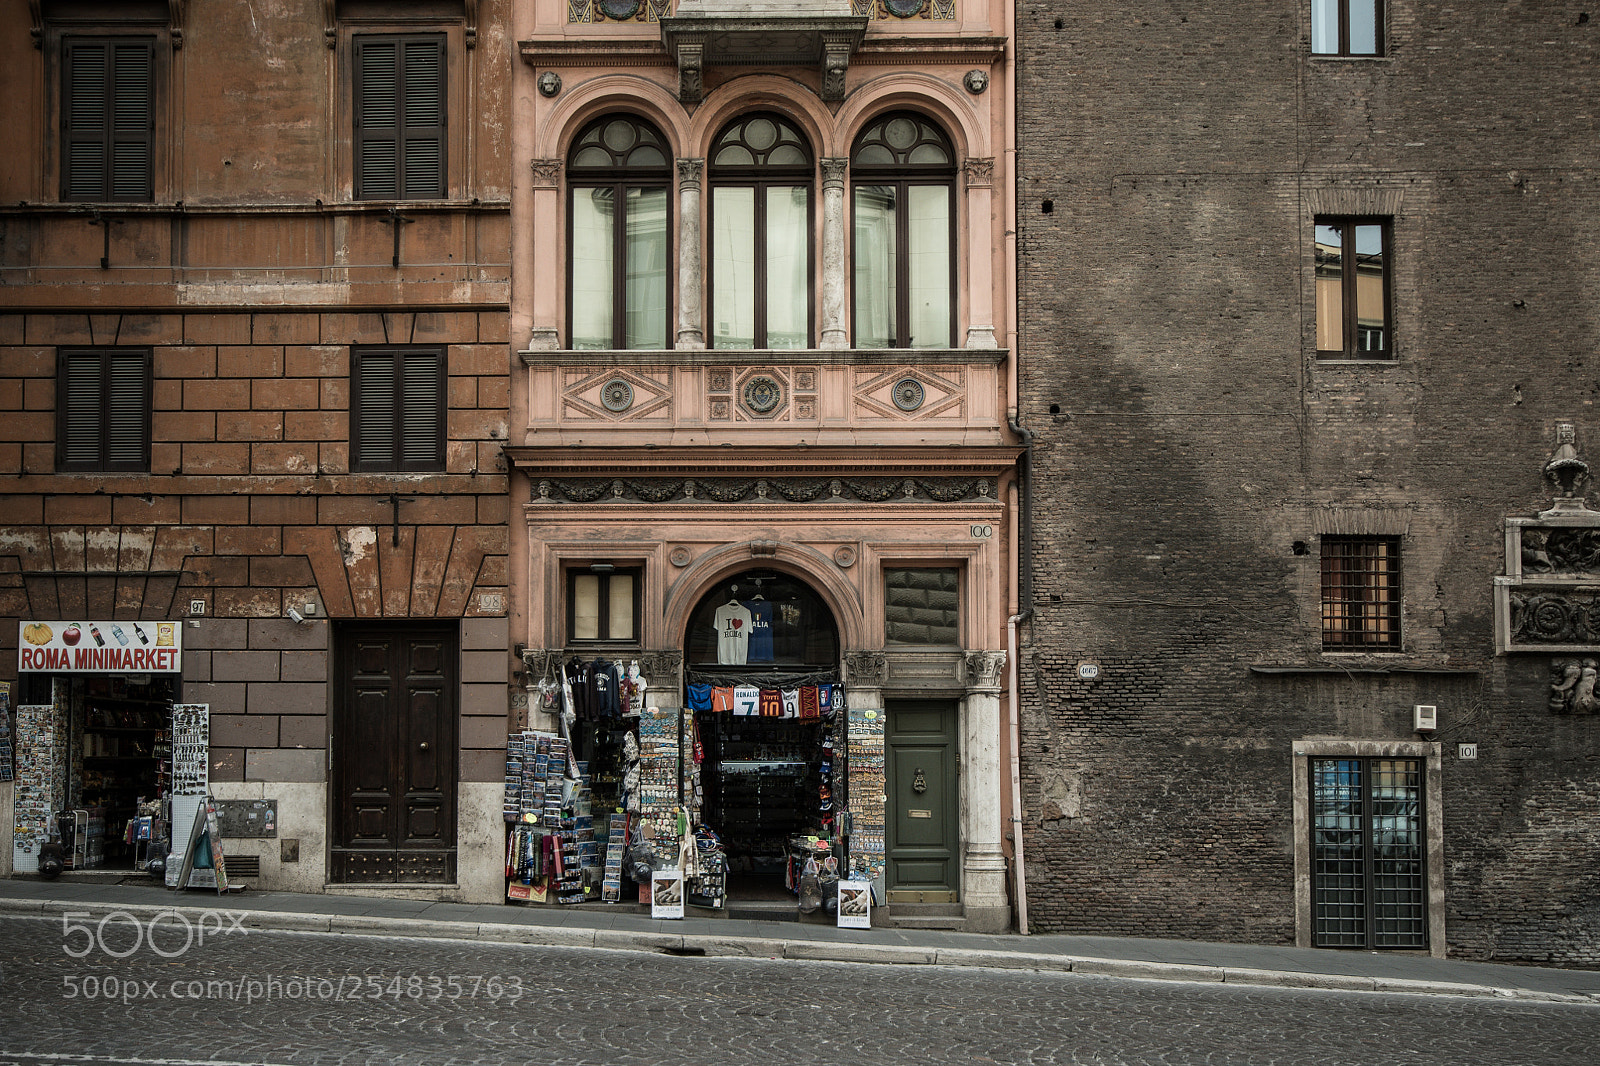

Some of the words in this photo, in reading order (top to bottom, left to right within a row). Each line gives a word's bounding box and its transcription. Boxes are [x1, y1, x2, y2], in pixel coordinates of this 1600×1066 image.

[970, 525, 993, 538] 100
[192, 602, 204, 612] 97
[483, 595, 500, 607] 98
[725, 618, 733, 630] I
[21, 648, 71, 670] ROMA
[74, 648, 178, 670] MINIMARKET
[741, 701, 755, 716] 7
[762, 701, 780, 717] 10
[786, 701, 795, 719] 9
[1461, 747, 1475, 757] 101
